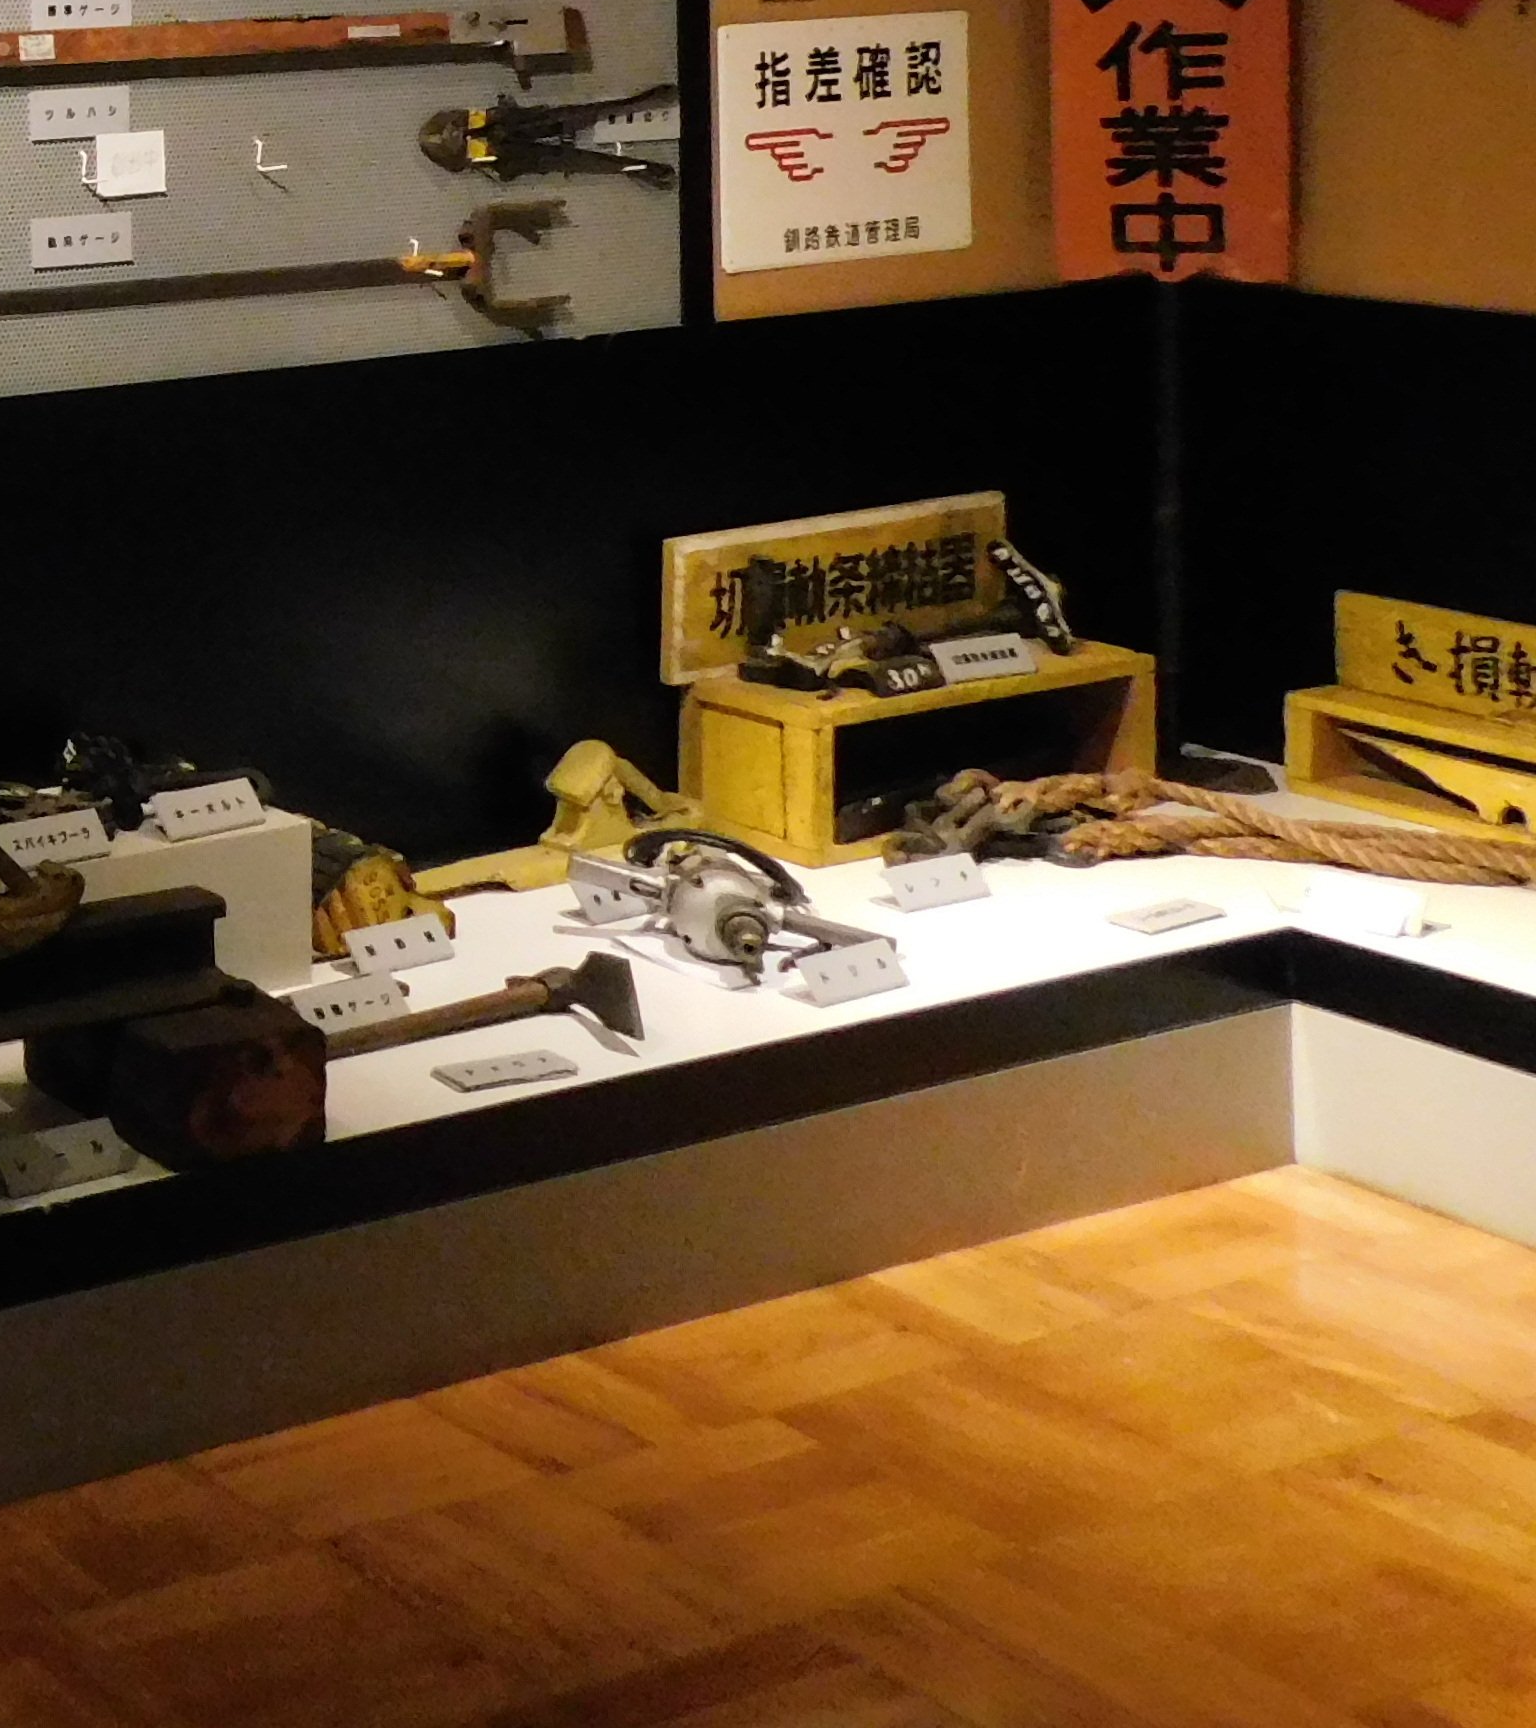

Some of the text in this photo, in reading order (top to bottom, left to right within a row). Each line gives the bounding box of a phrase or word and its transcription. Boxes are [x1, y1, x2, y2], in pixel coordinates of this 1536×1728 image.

[754, 39, 944, 111] 指差確認
[1096, 20, 1230, 273] 作業中
